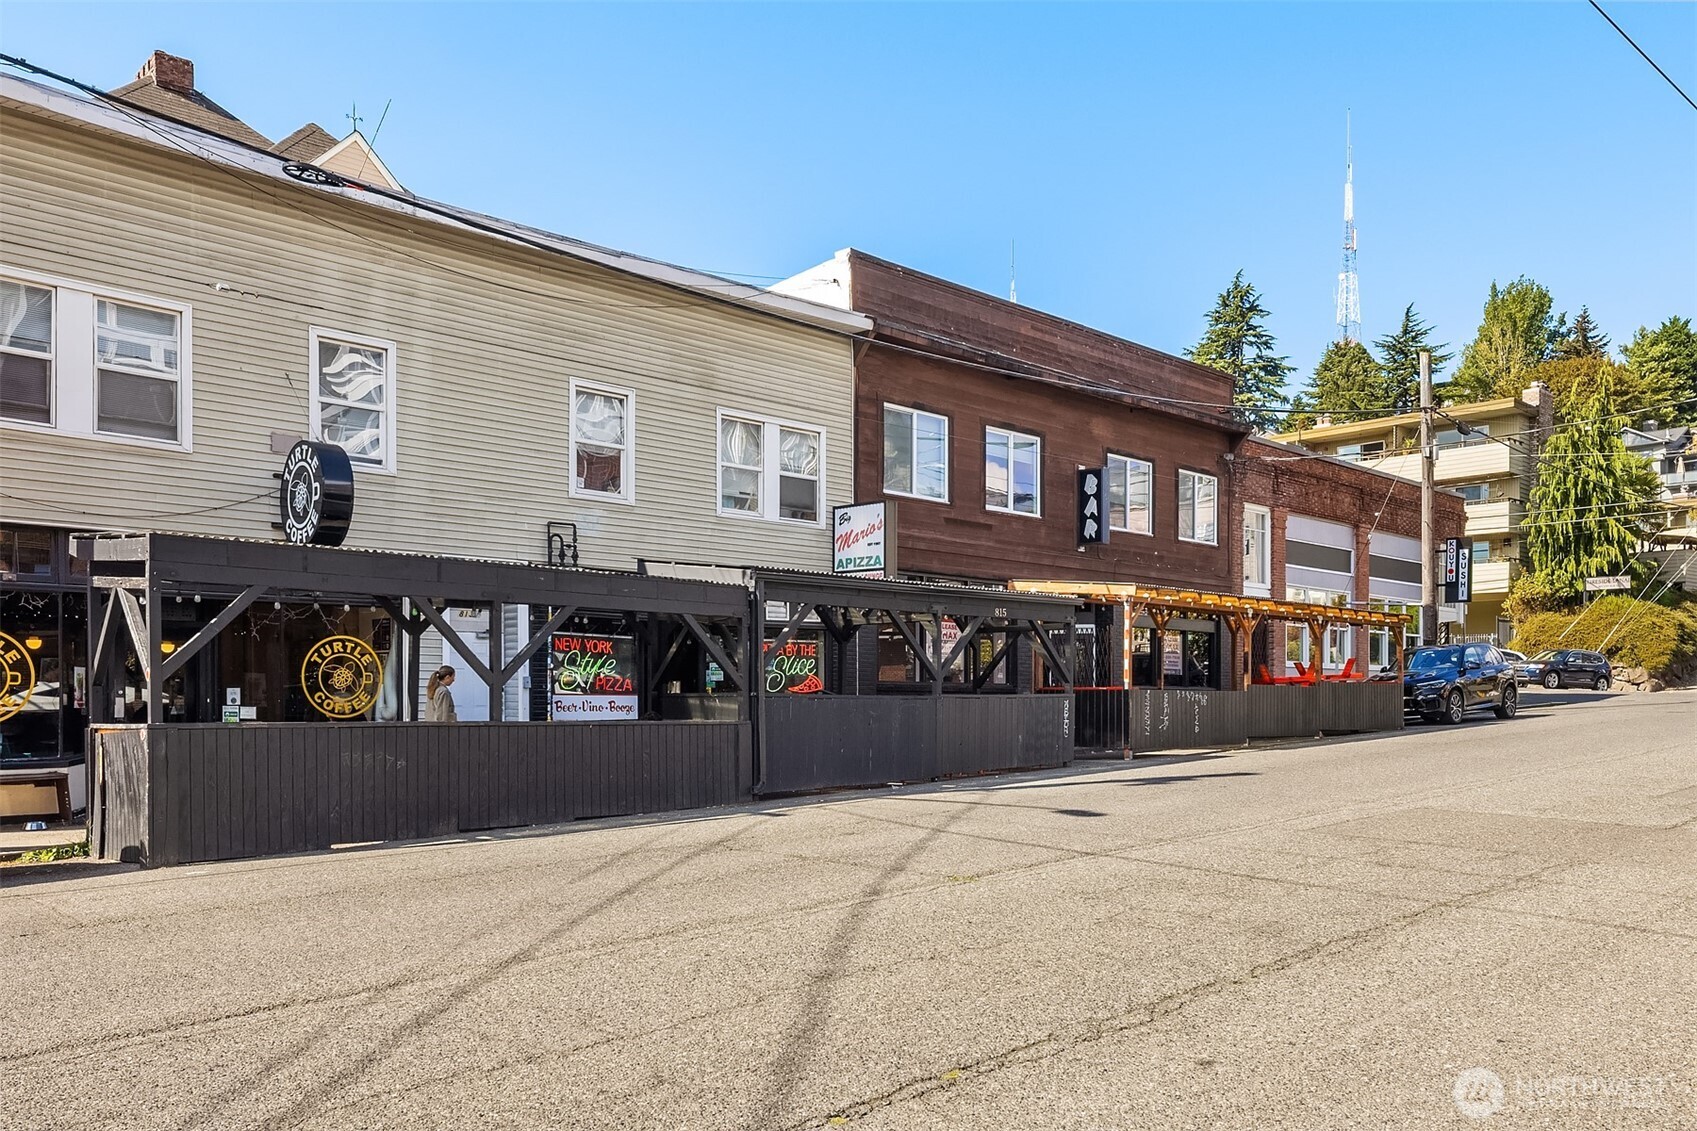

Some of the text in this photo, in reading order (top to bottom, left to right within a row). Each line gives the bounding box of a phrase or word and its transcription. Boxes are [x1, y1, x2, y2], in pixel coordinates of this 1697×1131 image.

[283, 445, 319, 481] TURTLE
[1084, 474, 1098, 539] BAR
[286, 509, 319, 544] COFFEE
[838, 512, 852, 526] Big
[835, 513, 884, 553] Mario's
[836, 555, 883, 570] APIZZA
[994, 607, 1007, 617] 815
[310, 641, 373, 666] TURTLE
[554, 637, 613, 654] NEW YORK
[786, 644, 798, 656] BY
[800, 644, 816, 656] THE
[561, 650, 617, 690] Style
[766, 655, 817, 693] Slice
[595, 676, 633, 692] PIZZA
[314, 691, 371, 714] COFFEE
[608, 700, 635, 716] Booze
